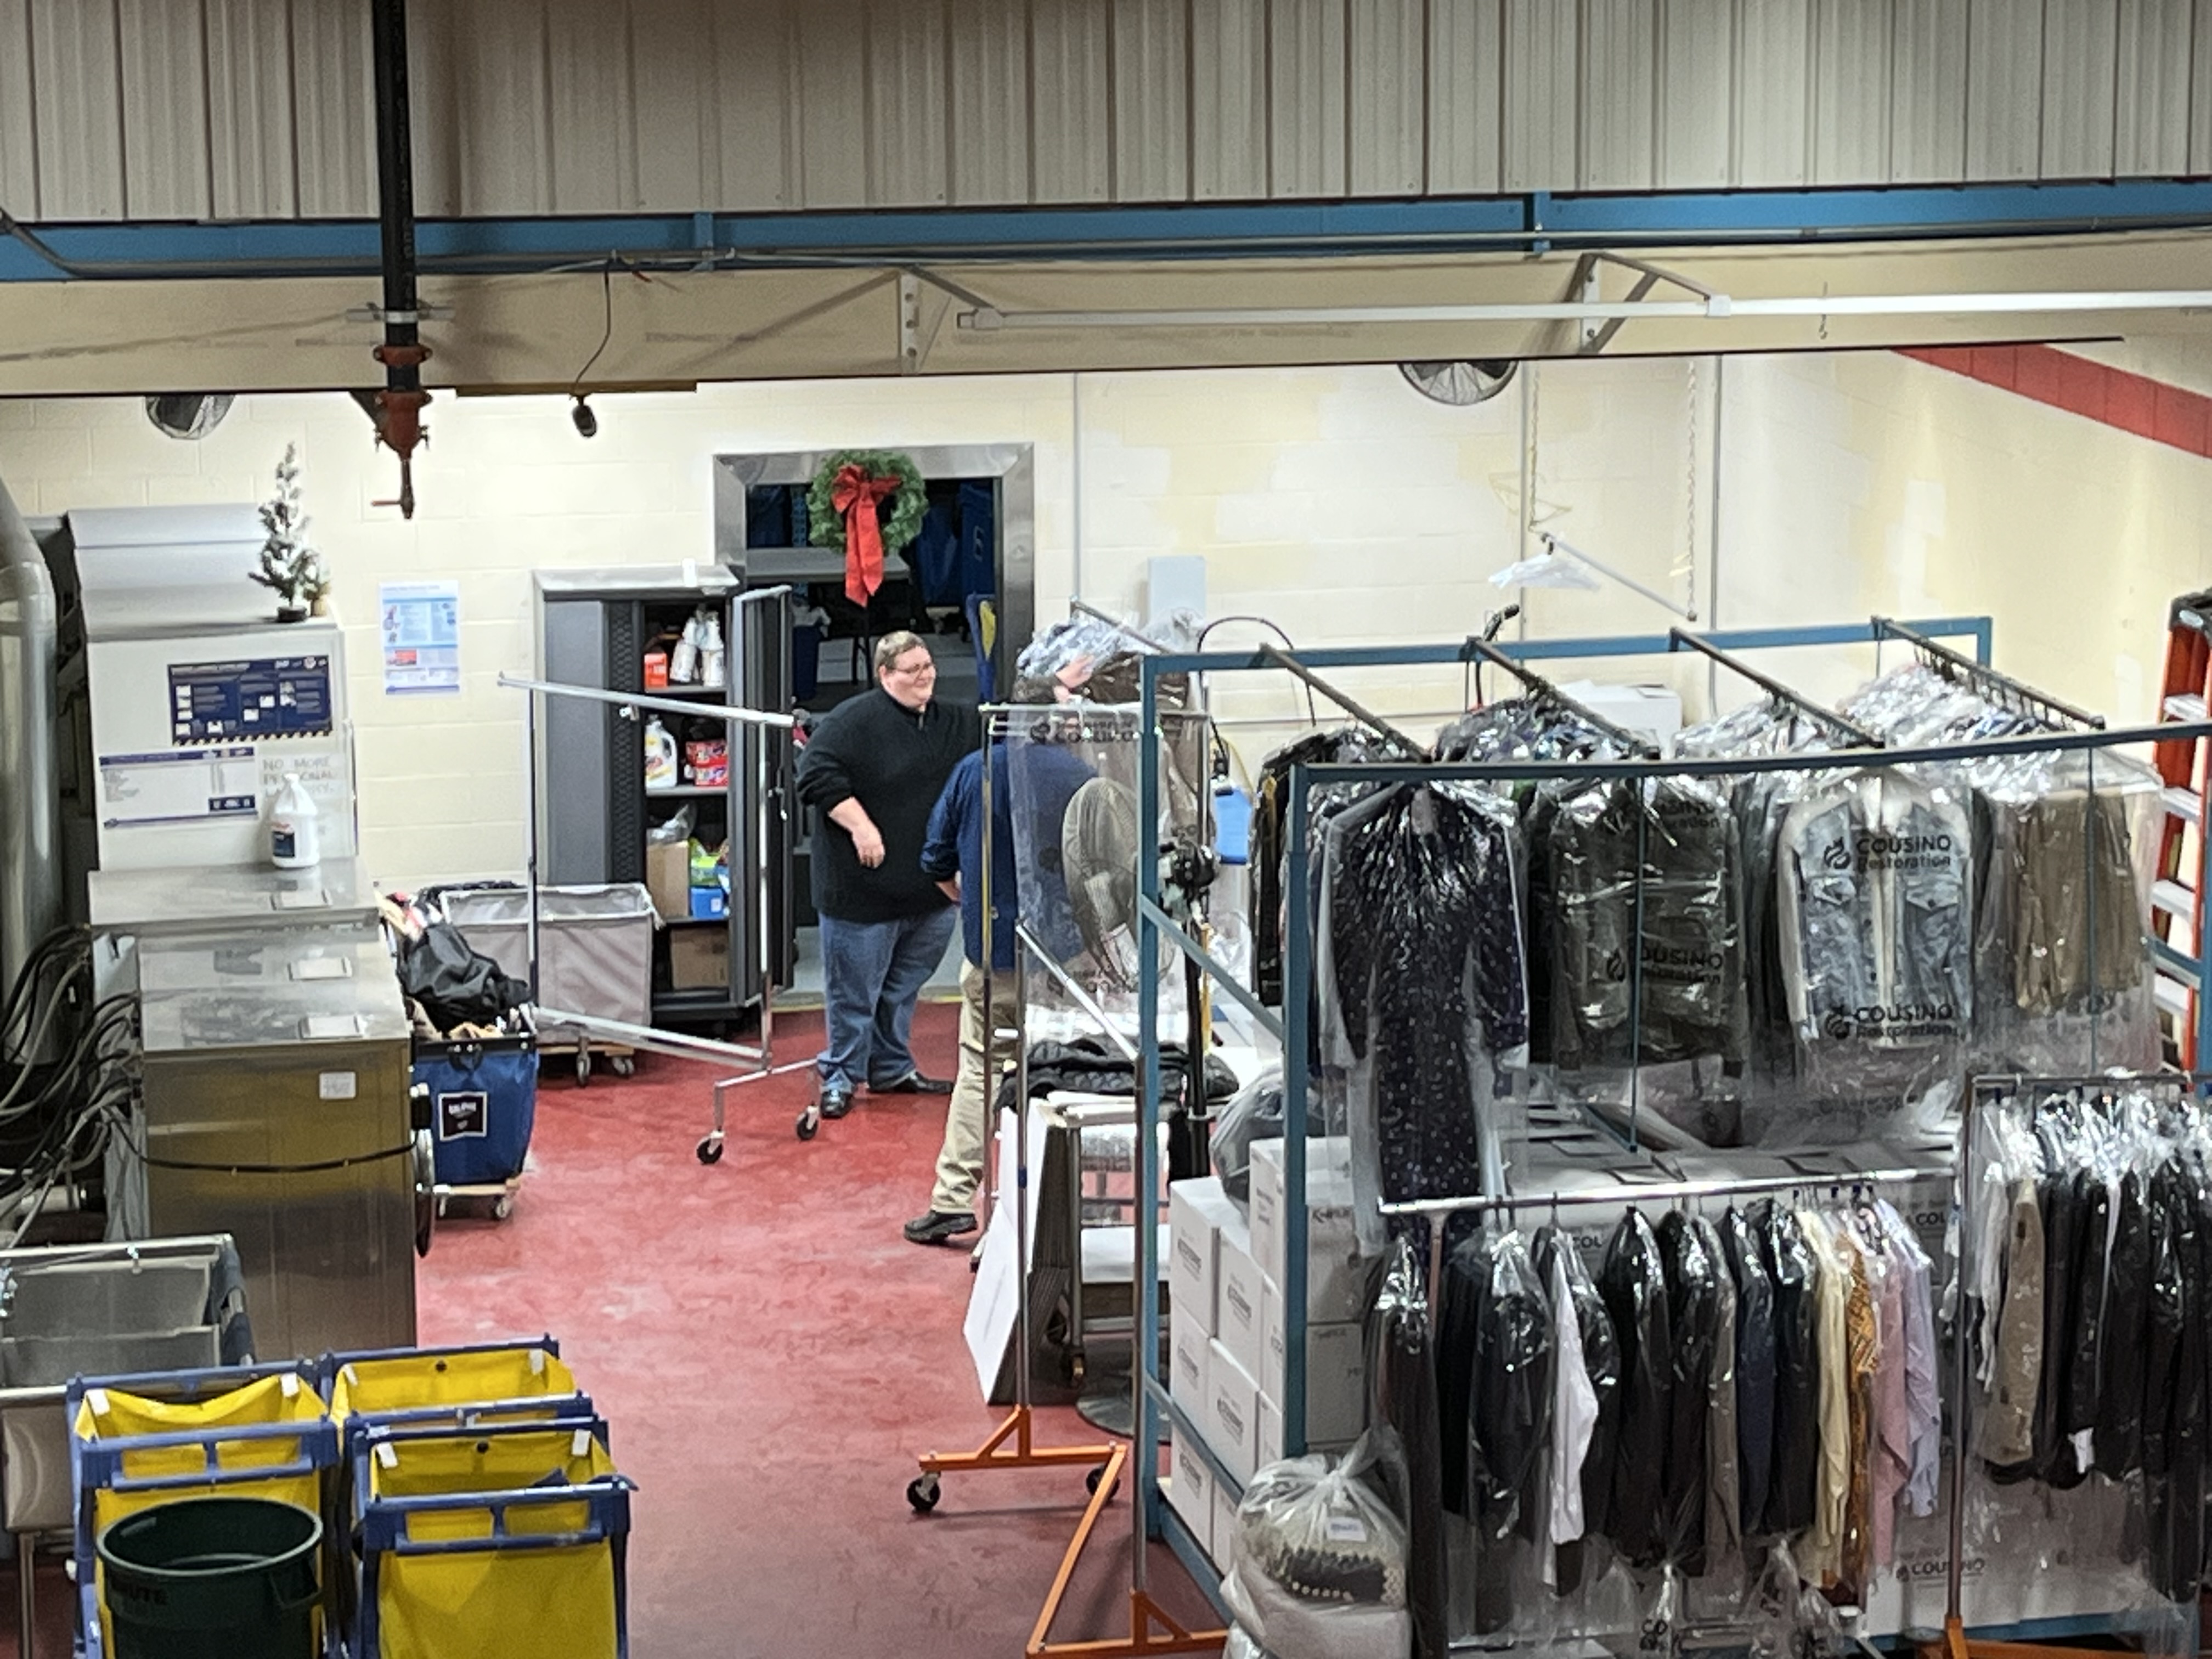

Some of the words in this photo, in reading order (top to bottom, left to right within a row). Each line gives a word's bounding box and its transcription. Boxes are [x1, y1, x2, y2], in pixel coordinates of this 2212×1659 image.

[262, 759, 284, 771] NO
[1857, 834, 1952, 854] COUSINO
[1857, 854, 1951, 872] Restoration
[1640, 946, 1723, 969] OUSINO
[1854, 1003, 1953, 1023] COUSINO
[1911, 1558, 1985, 1575] COUNO
